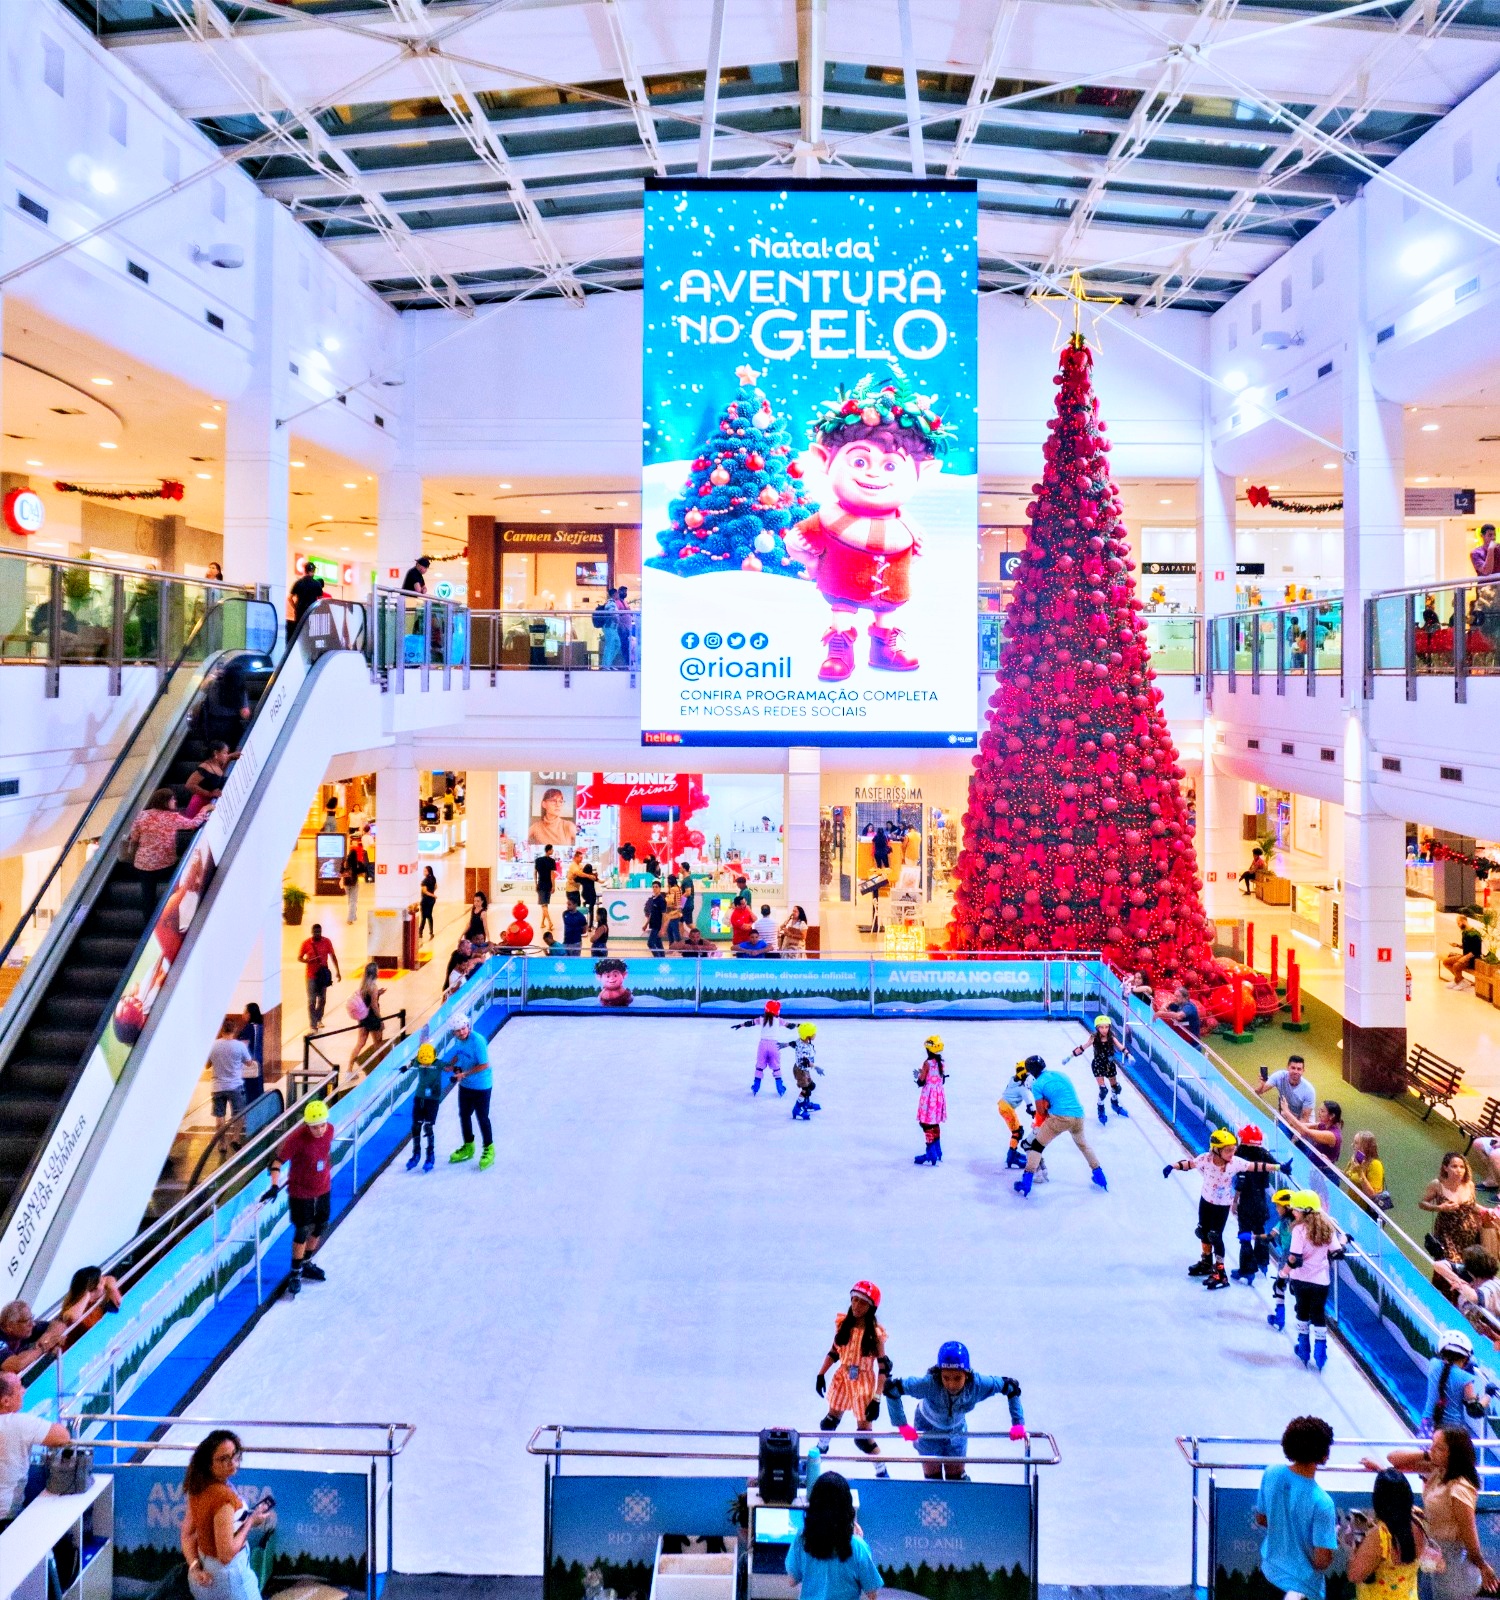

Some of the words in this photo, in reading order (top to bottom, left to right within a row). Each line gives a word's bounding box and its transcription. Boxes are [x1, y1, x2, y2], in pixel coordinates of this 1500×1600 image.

[750, 237, 828, 259] Natal
[835, 237, 873, 260] da
[680, 270, 942, 303] AVENTURA
[680, 314, 741, 343] NO
[751, 308, 949, 360] GELO
[1456, 498, 1469, 507] L2
[503, 530, 552, 542] Carmen
[553, 530, 604, 545] Steffens
[680, 657, 792, 681] @rioanil
[680, 690, 742, 702] CONFIRA
[746, 688, 859, 705] PROGRAMAÇÃO
[862, 690, 938, 702] COMPLETA
[680, 706, 699, 717] EM
[703, 706, 760, 717] NOSSAS
[764, 706, 807, 717] REDES
[811, 706, 867, 717] SOCIAIS
[626, 773, 677, 785] DINIZ
[625, 784, 678, 803] prime
[855, 785, 923, 800] RASTEIRÍSSIMA
[577, 811, 601, 820] NIZ
[715, 971, 738, 979] Pista
[740, 972, 778, 981] gigante,
[780, 971, 819, 979] diversão
[821, 971, 857, 979] infinita!
[888, 970, 967, 983] AVENTURA
[969, 970, 992, 983] NO
[993, 970, 1030, 983] GELO
[17, 1181, 46, 1237] SANTA
[44, 1129, 70, 1180] LOLLA
[7, 1256, 19, 1278] IS
[17, 1218, 37, 1255] OUT
[35, 1184, 54, 1221] FOR
[52, 1114, 87, 1185] SUMMER
[904, 1536, 930, 1549] RIO
